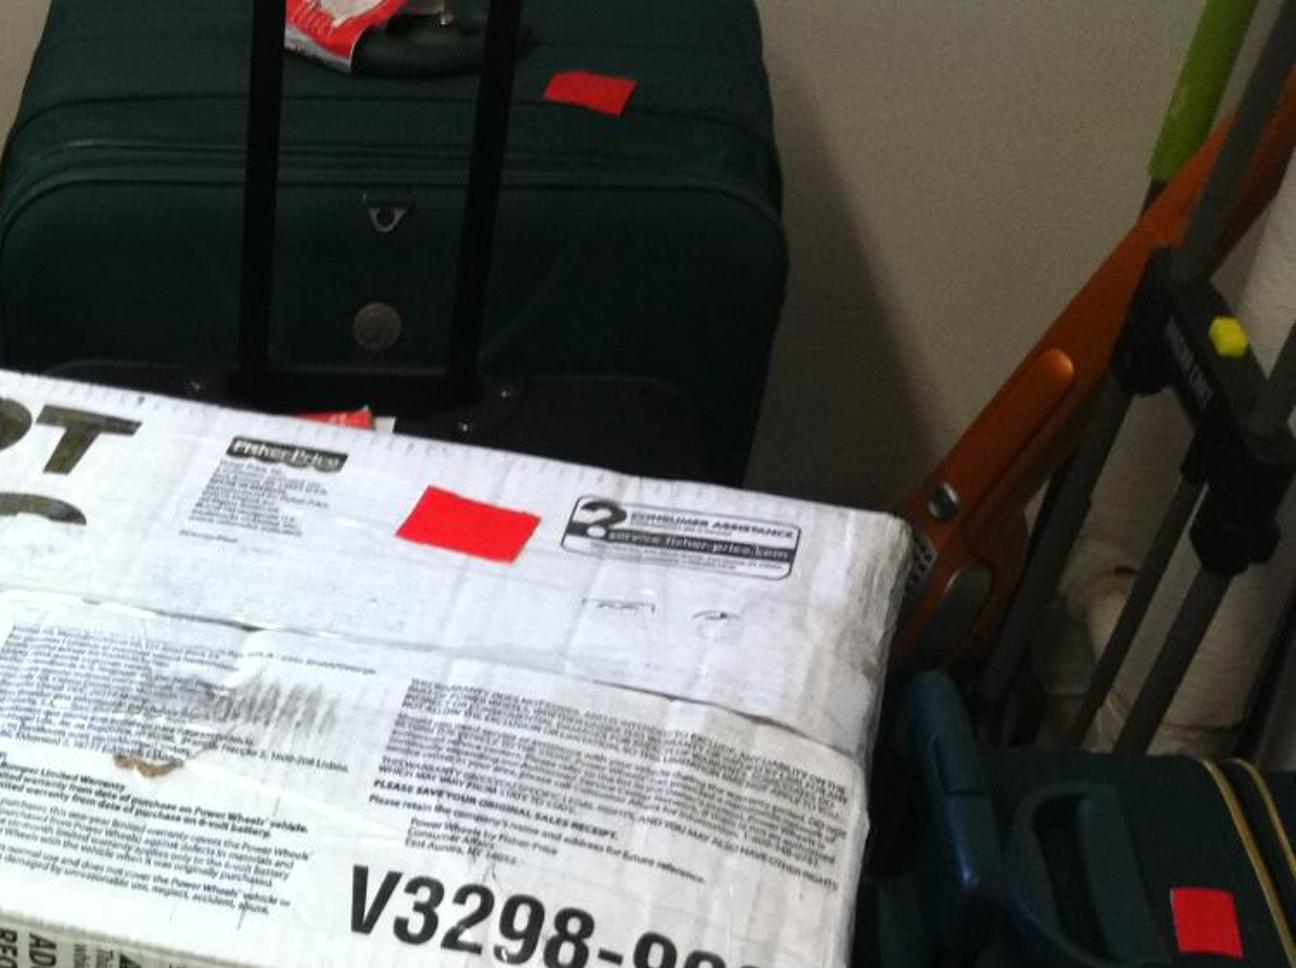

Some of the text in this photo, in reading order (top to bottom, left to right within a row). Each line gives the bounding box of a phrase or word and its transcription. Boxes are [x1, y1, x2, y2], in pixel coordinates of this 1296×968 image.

[369, 794, 400, 807] Please
[434, 804, 451, 815] the
[510, 823, 539, 835] name
[542, 830, 562, 841] and
[564, 836, 604, 852] address
[374, 779, 413, 793] PLEASE
[417, 787, 444, 798] SAVE
[447, 792, 476, 804] YOUR
[478, 800, 530, 817] ORIGINAL
[535, 812, 568, 827] SALES
